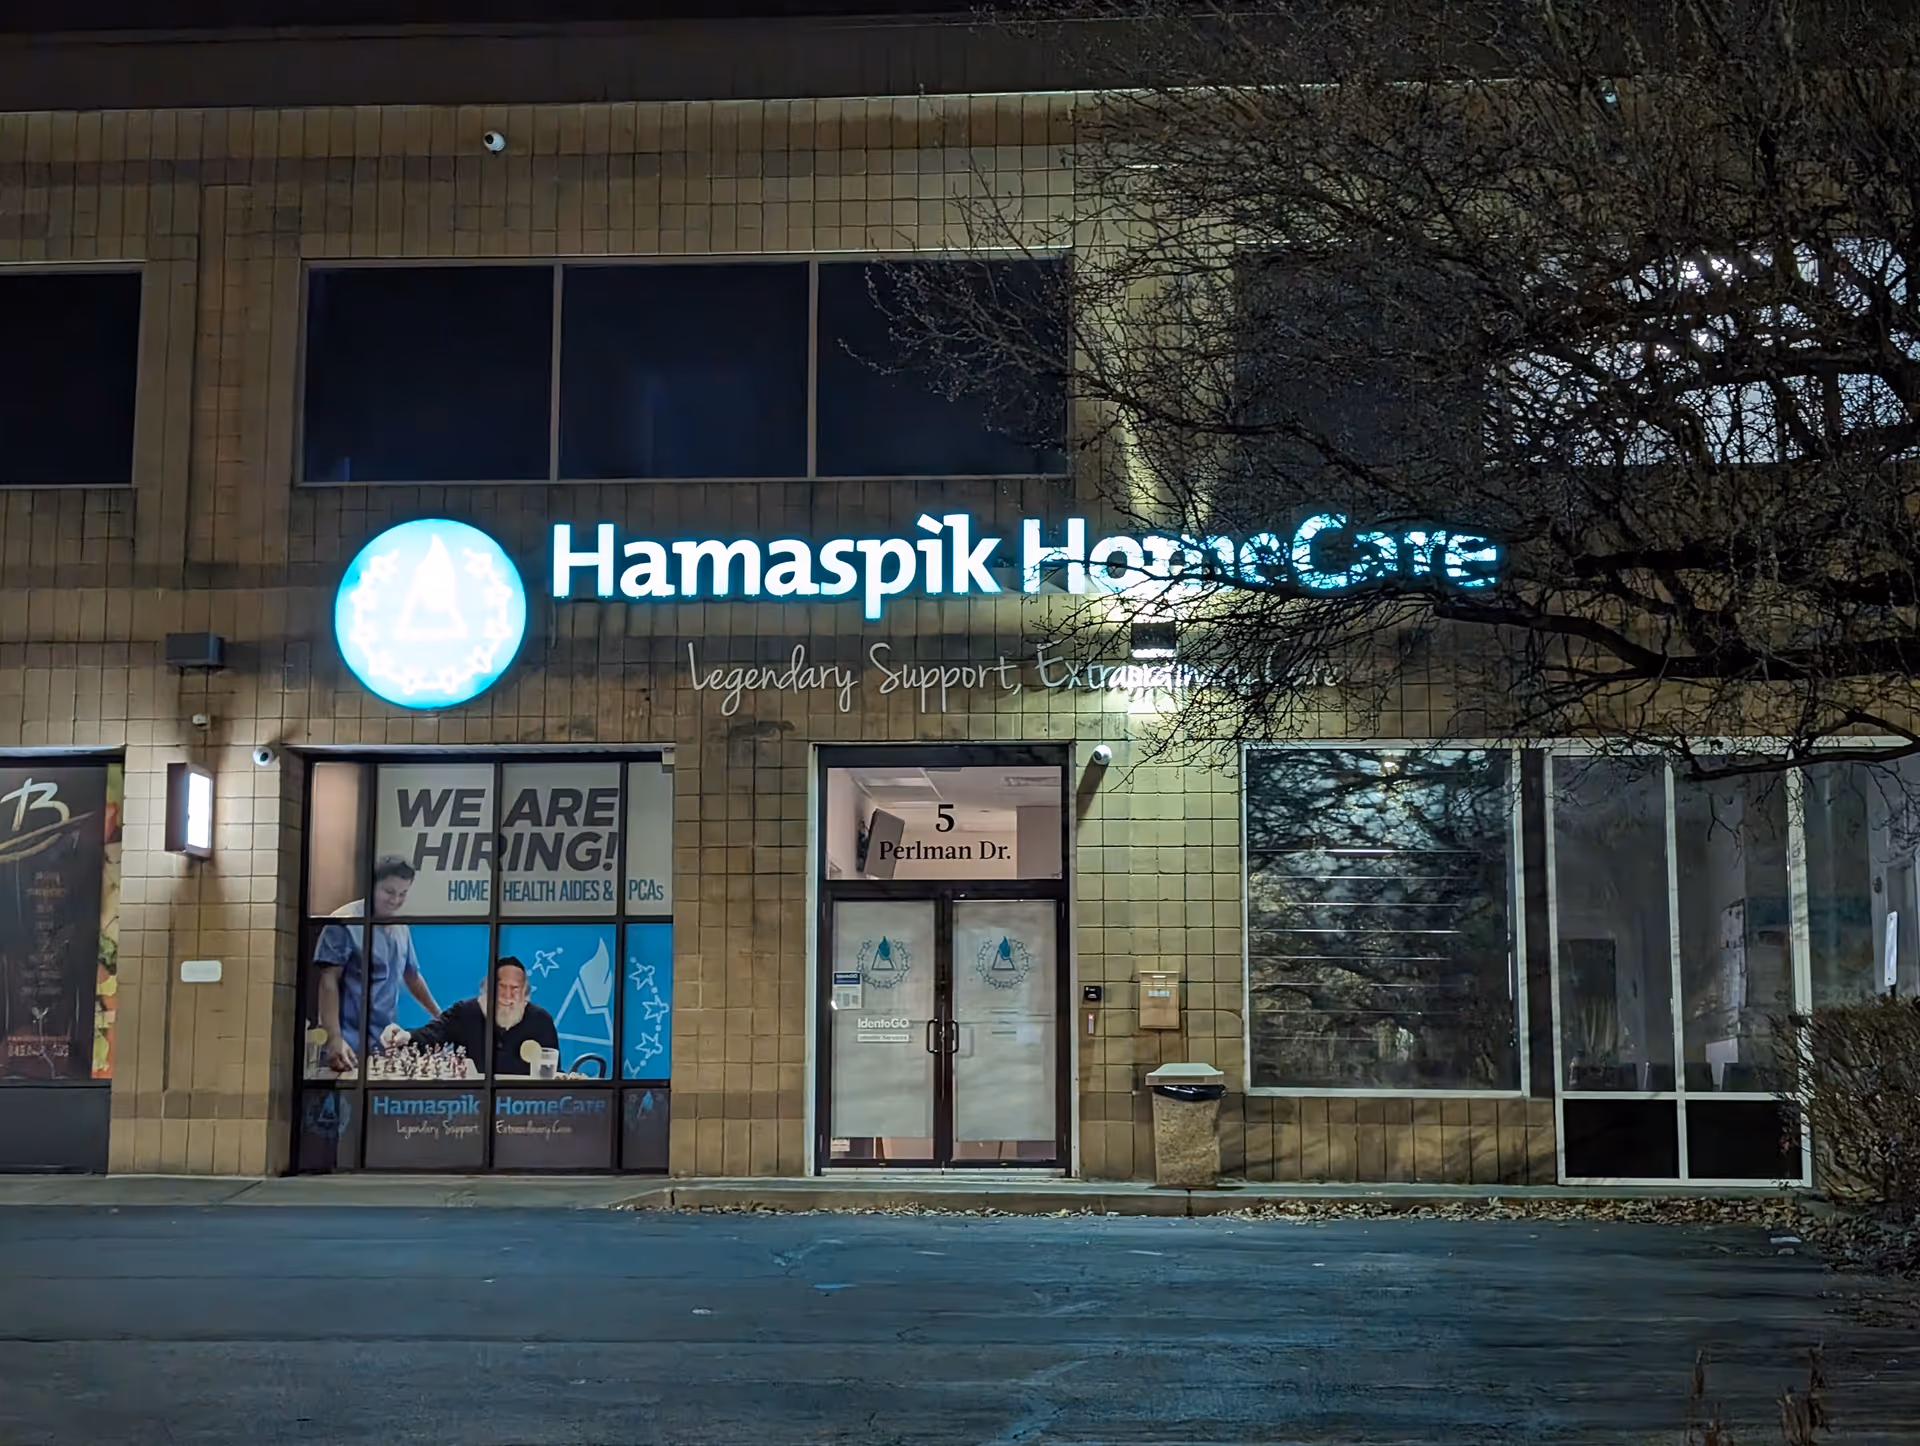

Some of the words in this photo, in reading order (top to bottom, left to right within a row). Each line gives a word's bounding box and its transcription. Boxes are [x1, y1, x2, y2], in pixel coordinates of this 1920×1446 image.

[552, 513, 1002, 620] Hamaspik
[687, 642, 858, 716] Legendary
[868, 642, 1022, 713] Support,
[396, 787, 487, 828] WE
[502, 787, 620, 828] ARE
[935, 803, 956, 833] 5
[411, 831, 621, 872] HIRING!
[879, 841, 972, 861] Perlman
[978, 841, 1012, 861] Dr.
[447, 879, 490, 902] HOME
[503, 879, 556, 902] HEALTH
[559, 880, 600, 902] AIDES
[602, 880, 614, 901] &
[628, 879, 665, 901] PCAs
[857, 1017, 910, 1030] IdentoGO
[373, 1094, 480, 1121] Hamaspik
[496, 1095, 607, 1116] HomeCare
